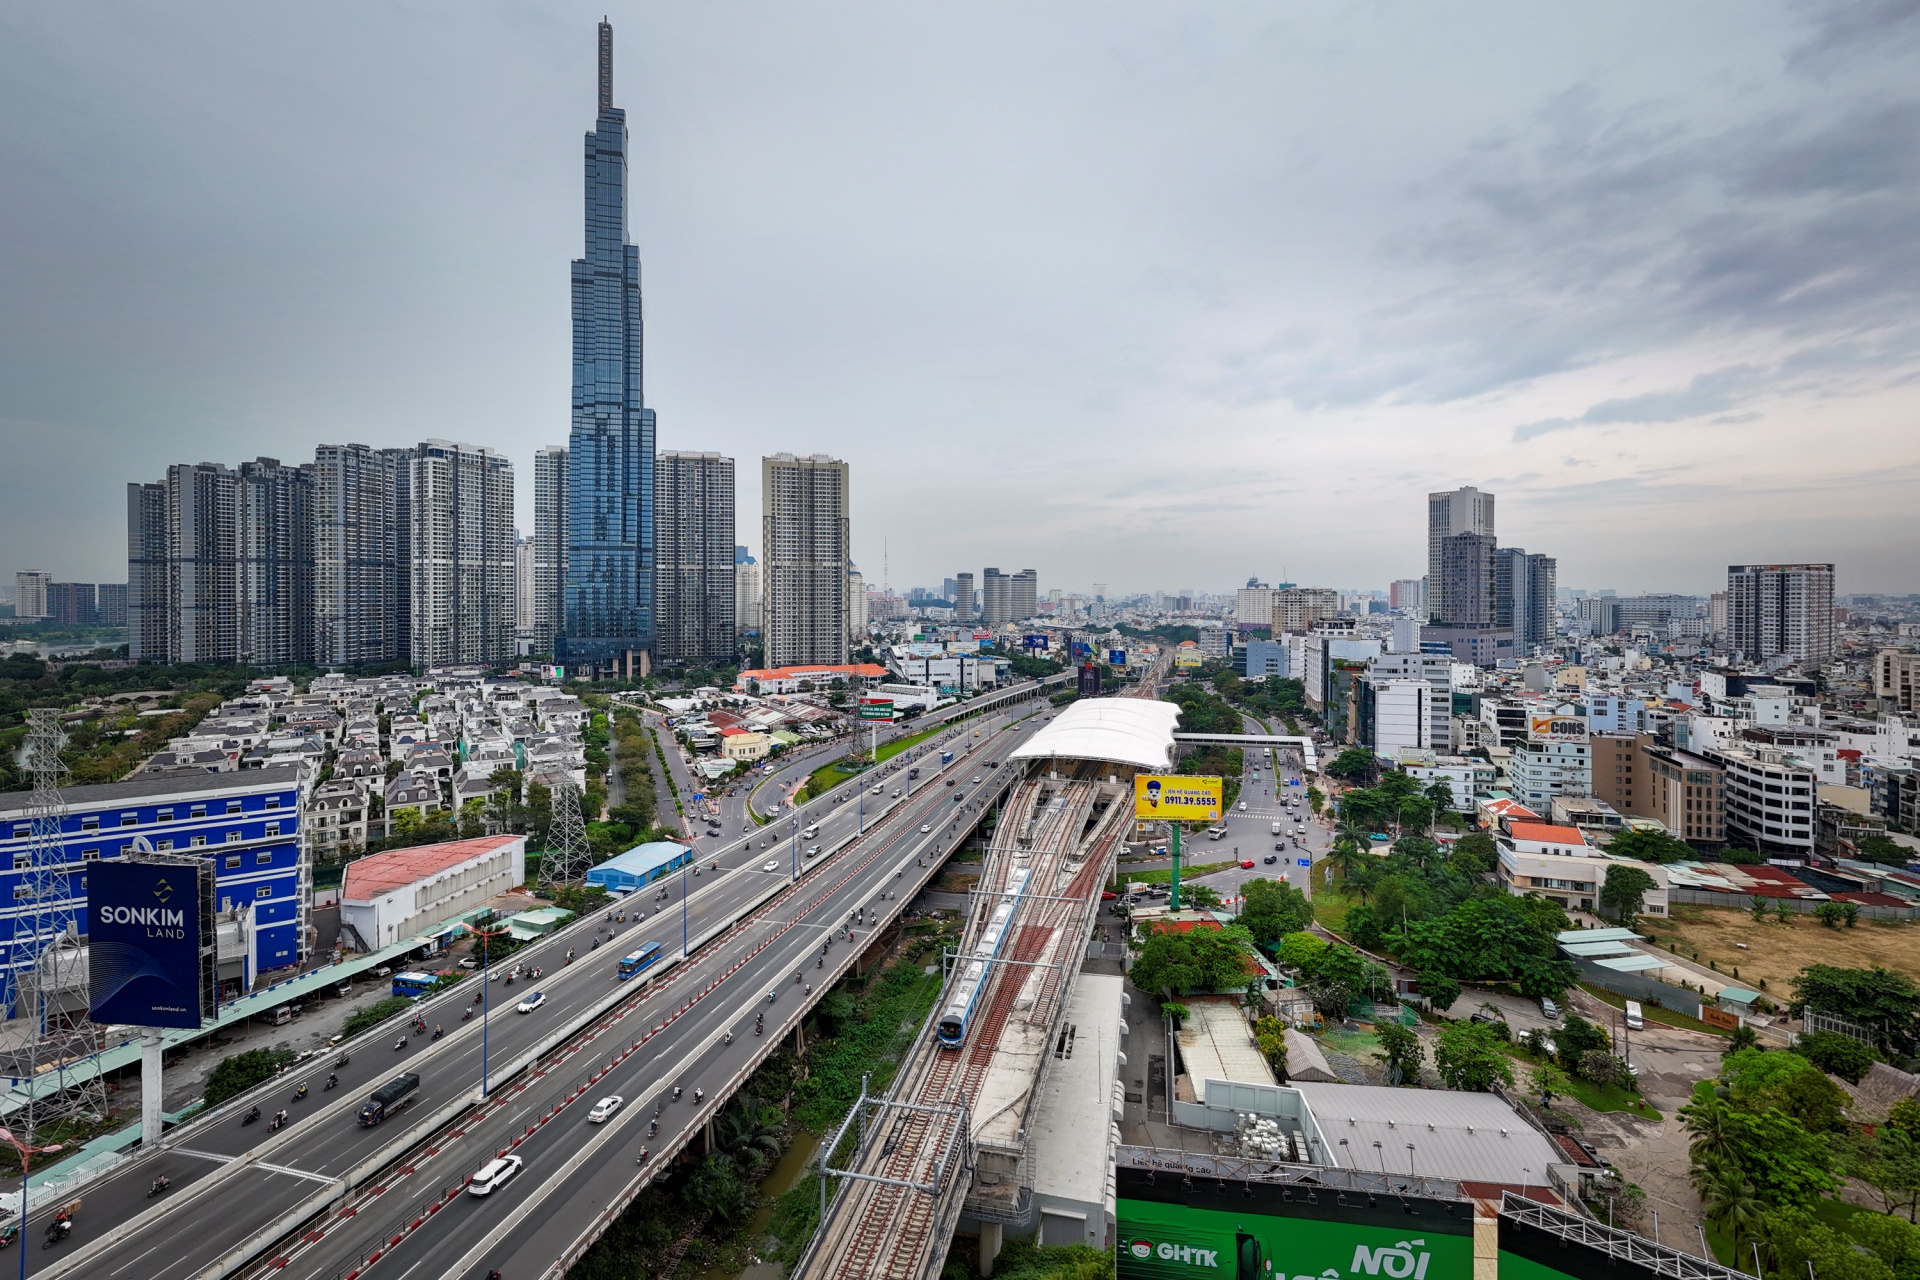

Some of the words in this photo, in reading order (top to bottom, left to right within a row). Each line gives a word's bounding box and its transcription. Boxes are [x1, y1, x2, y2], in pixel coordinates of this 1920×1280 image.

[1165, 796, 1217, 805] 0911.39.5555
[100, 906, 184, 927] SONKIM
[147, 928, 185, 939] LAND
[1157, 1242, 1218, 1268] GHTK
[1350, 1238, 1431, 1280] NỐI
